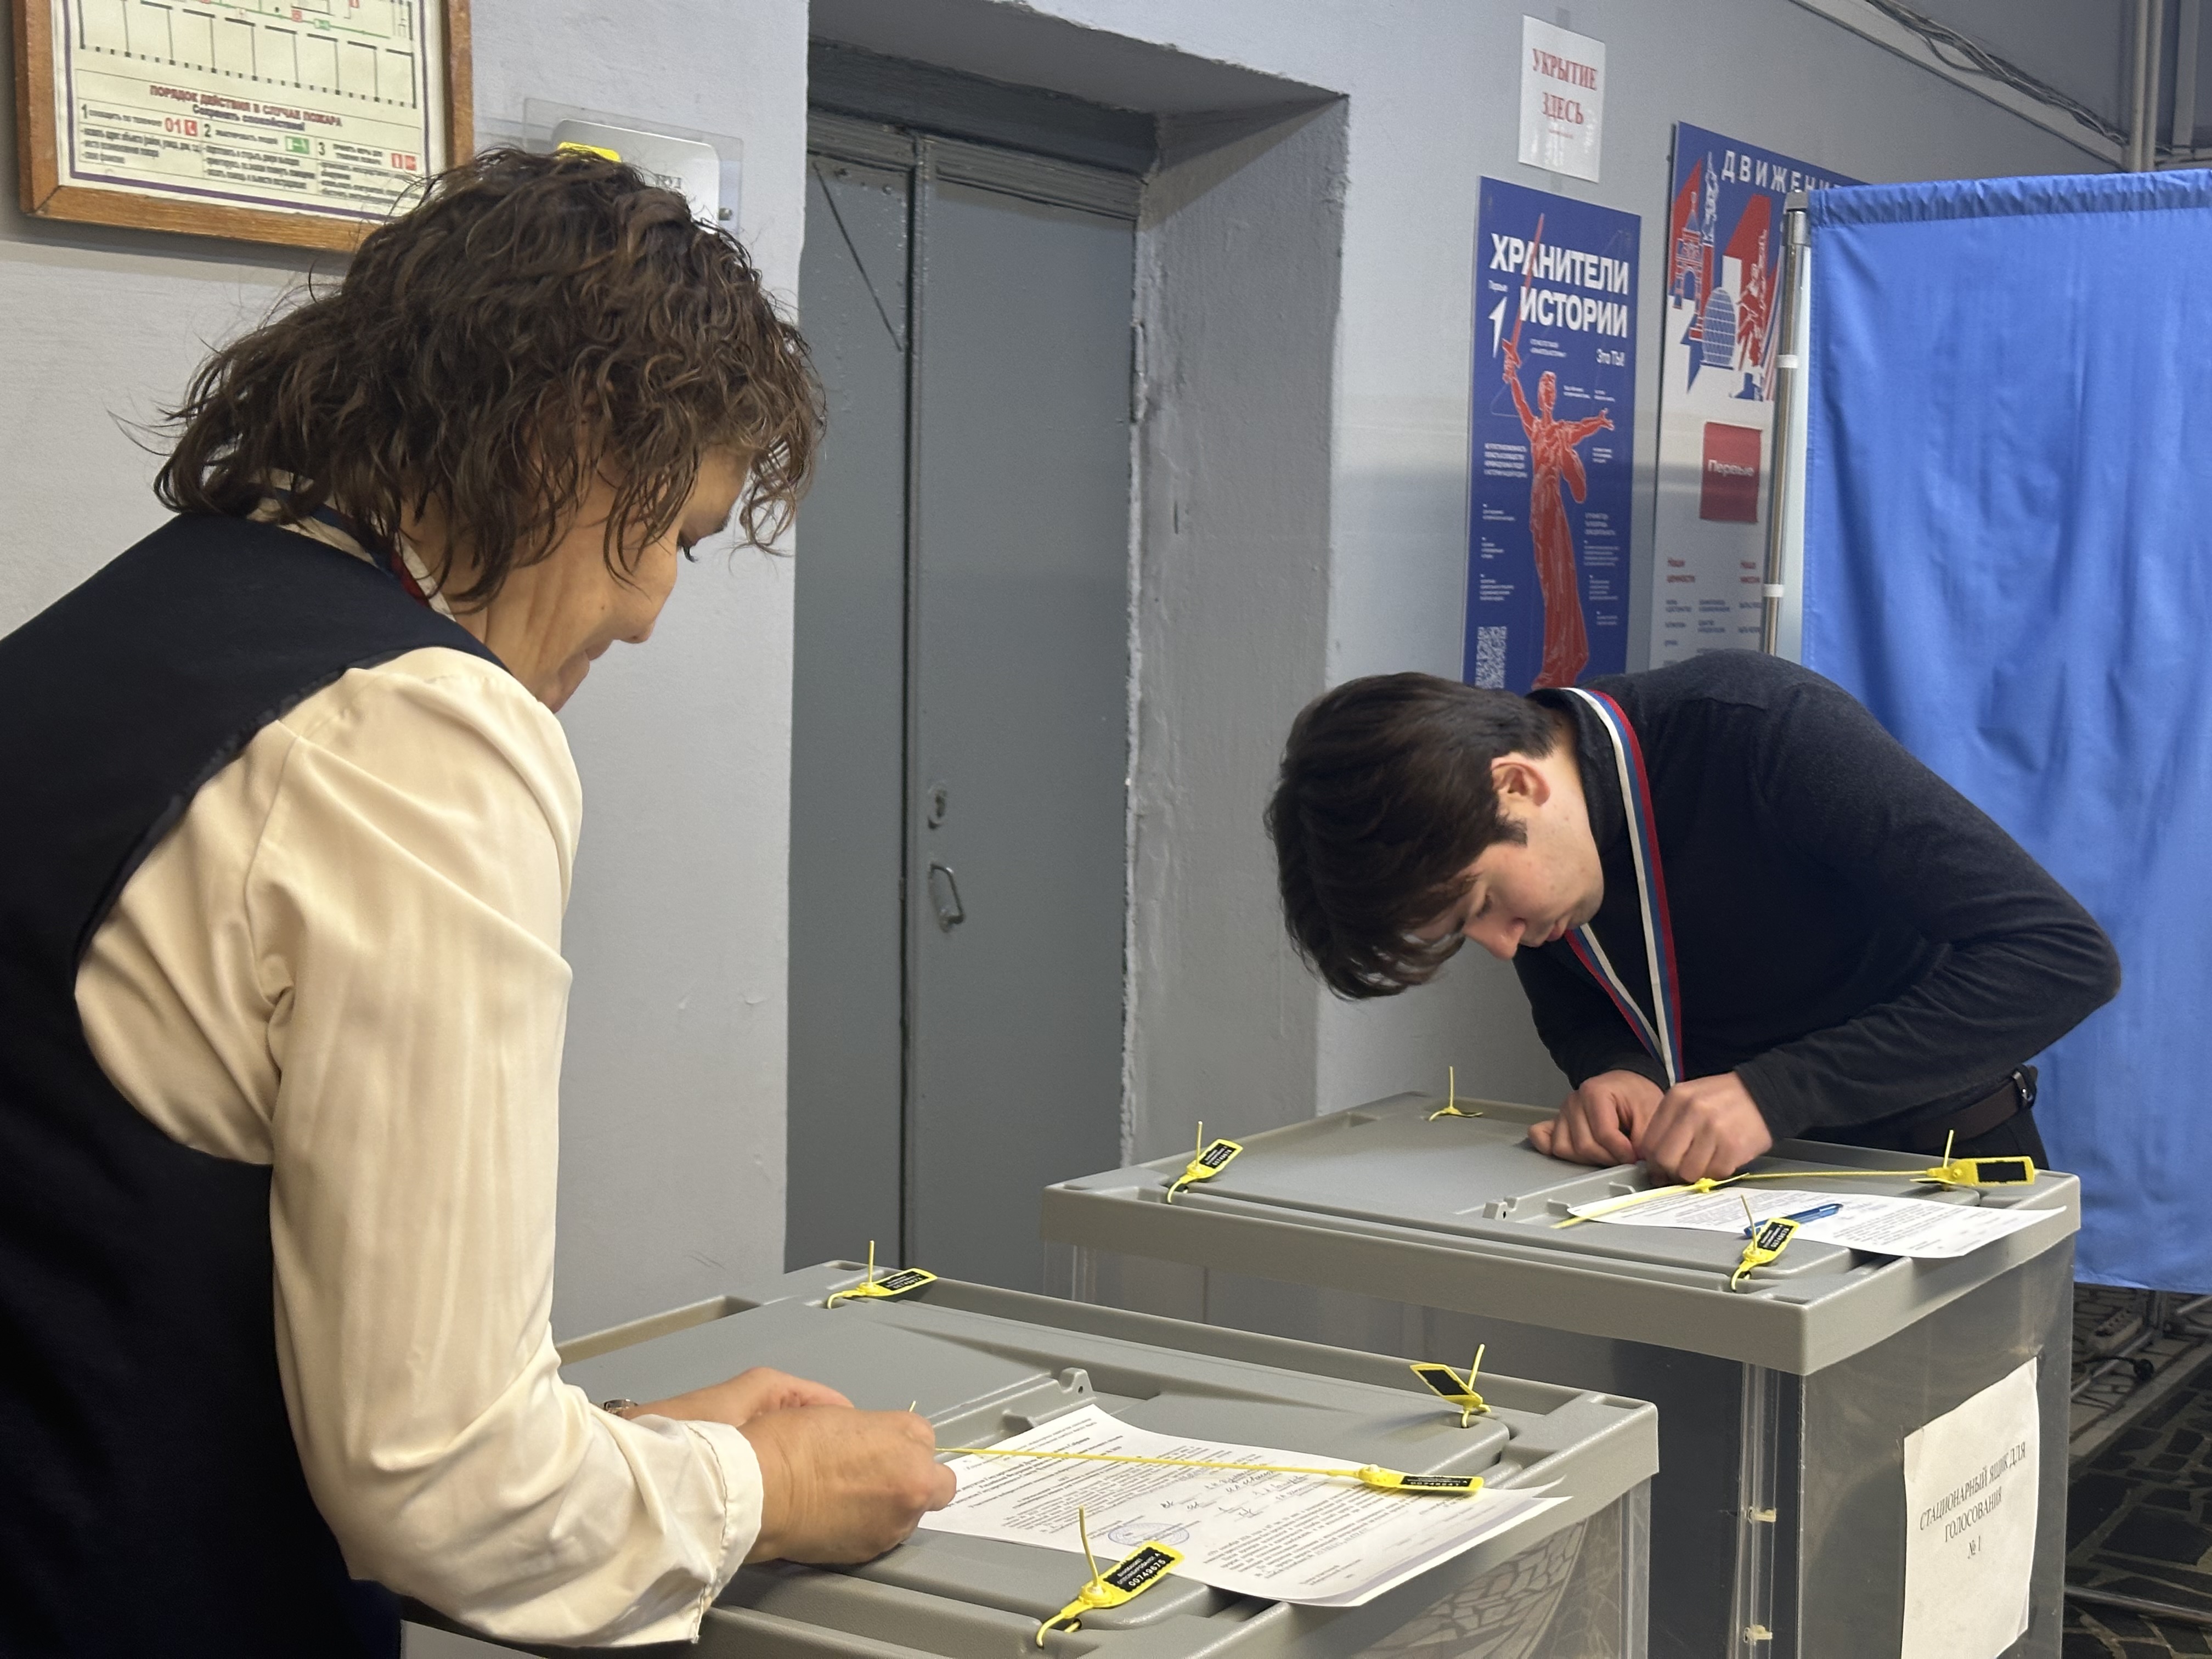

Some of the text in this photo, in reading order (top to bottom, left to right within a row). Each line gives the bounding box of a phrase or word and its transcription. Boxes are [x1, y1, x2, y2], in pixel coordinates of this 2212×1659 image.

[1533, 48, 1597, 91] УКРЫТИЕ
[81, 104, 87, 119] 1
[1542, 92, 1584, 125] ЗДЕСЬ
[165, 117, 182, 134] 01
[204, 124, 211, 138] 2
[318, 142, 326, 156] 3
[1721, 150, 1842, 194] ДВИЖЕН
[1489, 233, 1629, 295] ХРАНИТЕЛИ
[1520, 286, 1628, 338] ИСТОРИИ
[1708, 459, 1754, 477] Первые
[1920, 1441, 2026, 1531] СТАЦИОНАРНЫЙ ЯЩИК ДЛЯ
[1945, 1486, 2002, 1542] ГОЛОСОВАНИЯ
[1967, 1539, 1976, 1559] №
